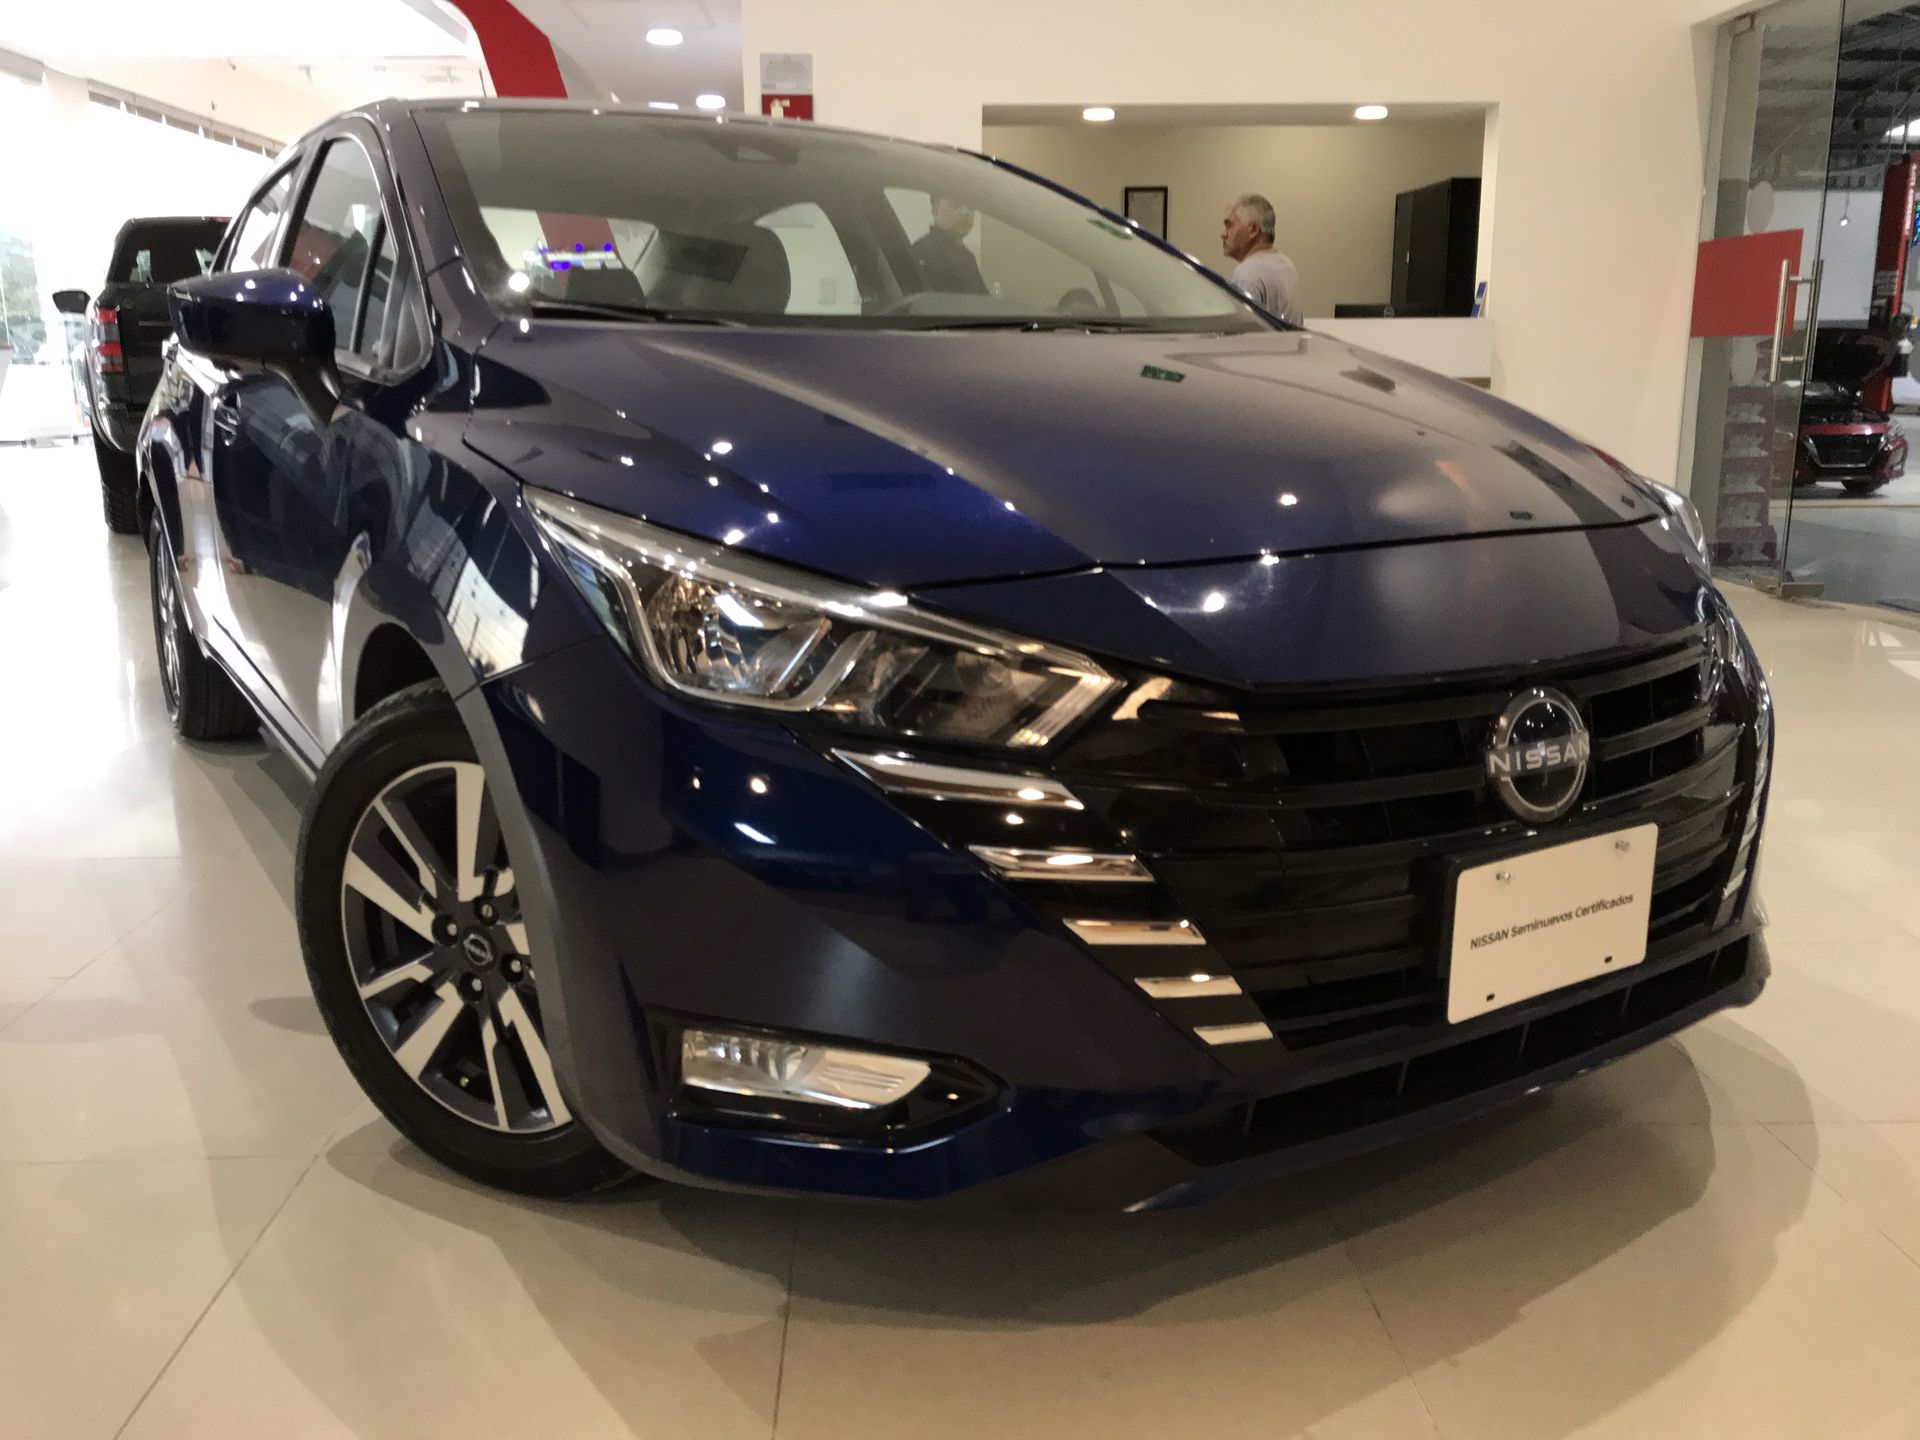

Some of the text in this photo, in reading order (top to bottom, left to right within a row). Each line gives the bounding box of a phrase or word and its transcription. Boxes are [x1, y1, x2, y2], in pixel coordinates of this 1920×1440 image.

[1489, 739, 1590, 774] NISSAN
[1470, 894, 1634, 950] NISSAN Seminuevos Certificados
